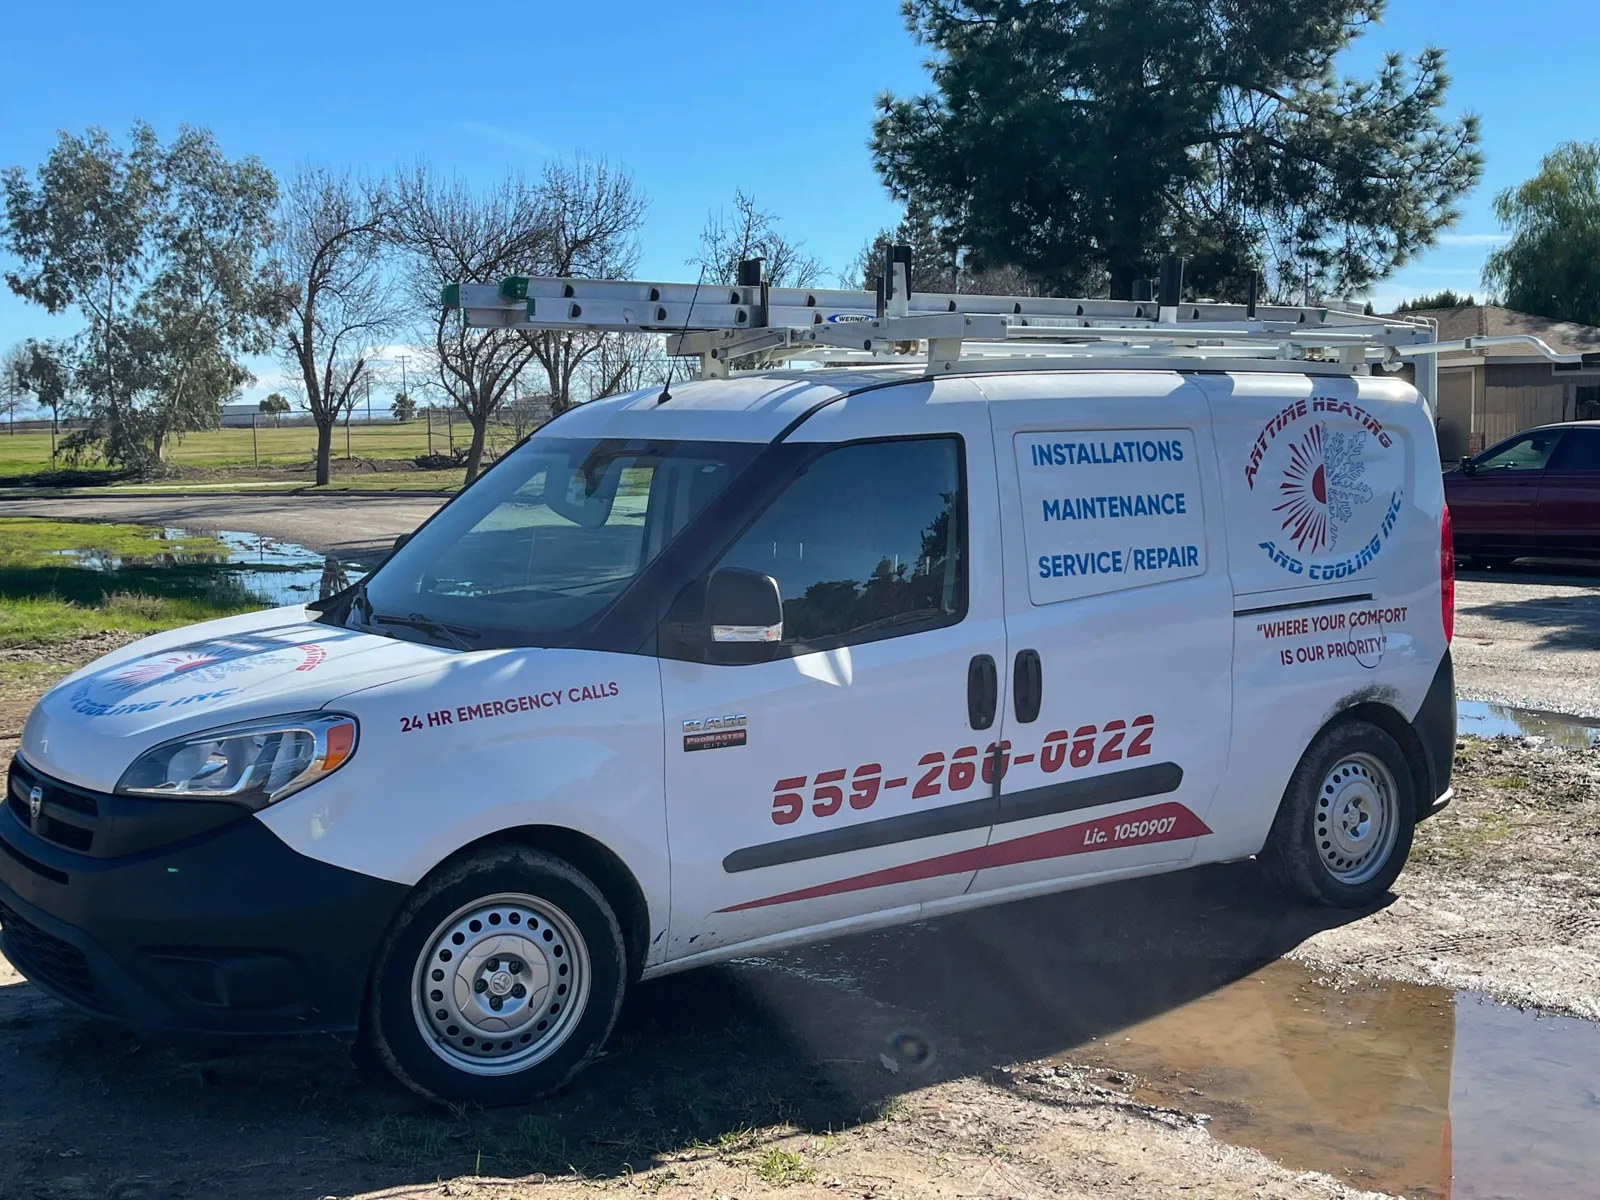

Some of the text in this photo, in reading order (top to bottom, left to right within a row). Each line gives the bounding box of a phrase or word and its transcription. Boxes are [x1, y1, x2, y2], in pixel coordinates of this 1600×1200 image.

[1031, 440, 1184, 466] INSTALLATIONS
[1245, 397, 1393, 491] ANYTIME HEATING
[1042, 493, 1187, 522] MAINTENANCE
[1258, 490, 1404, 581] AND COOLING INC.
[1038, 545, 1200, 579] SERVICE/REPAIR
[1311, 613, 1346, 632] YOUR
[1350, 606, 1408, 628] COMFORT
[1280, 649, 1294, 666] IS
[1296, 645, 1326, 664] OUR
[399, 681, 620, 733] 24 HR EMERGENCY CALLS
[683, 714, 747, 733] RAM
[703, 741, 729, 749] CITY
[1083, 816, 1177, 846] Lic. 1050907
